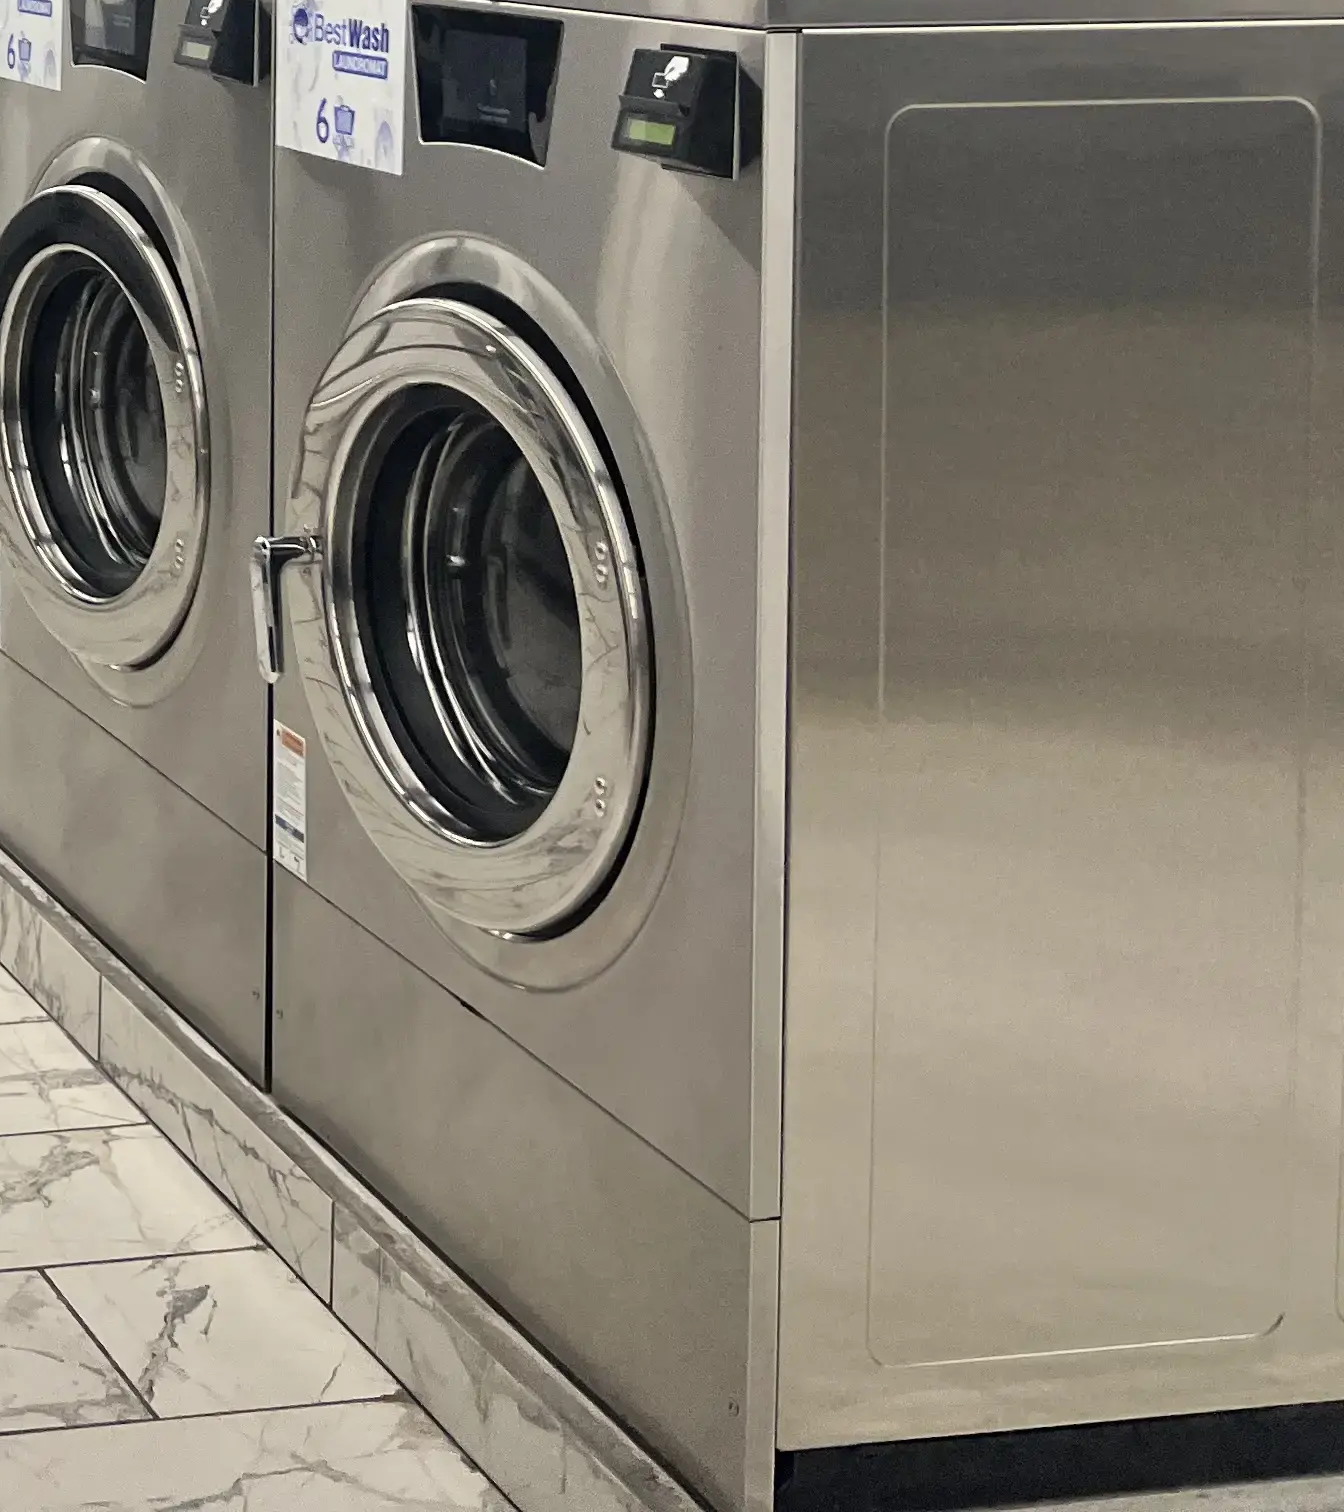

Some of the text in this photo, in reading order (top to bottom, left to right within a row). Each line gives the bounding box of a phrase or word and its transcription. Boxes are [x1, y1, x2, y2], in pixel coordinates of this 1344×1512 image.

[7, 33, 16, 69] 6
[314, 13, 390, 53] BestWash
[316, 97, 330, 144] 6
